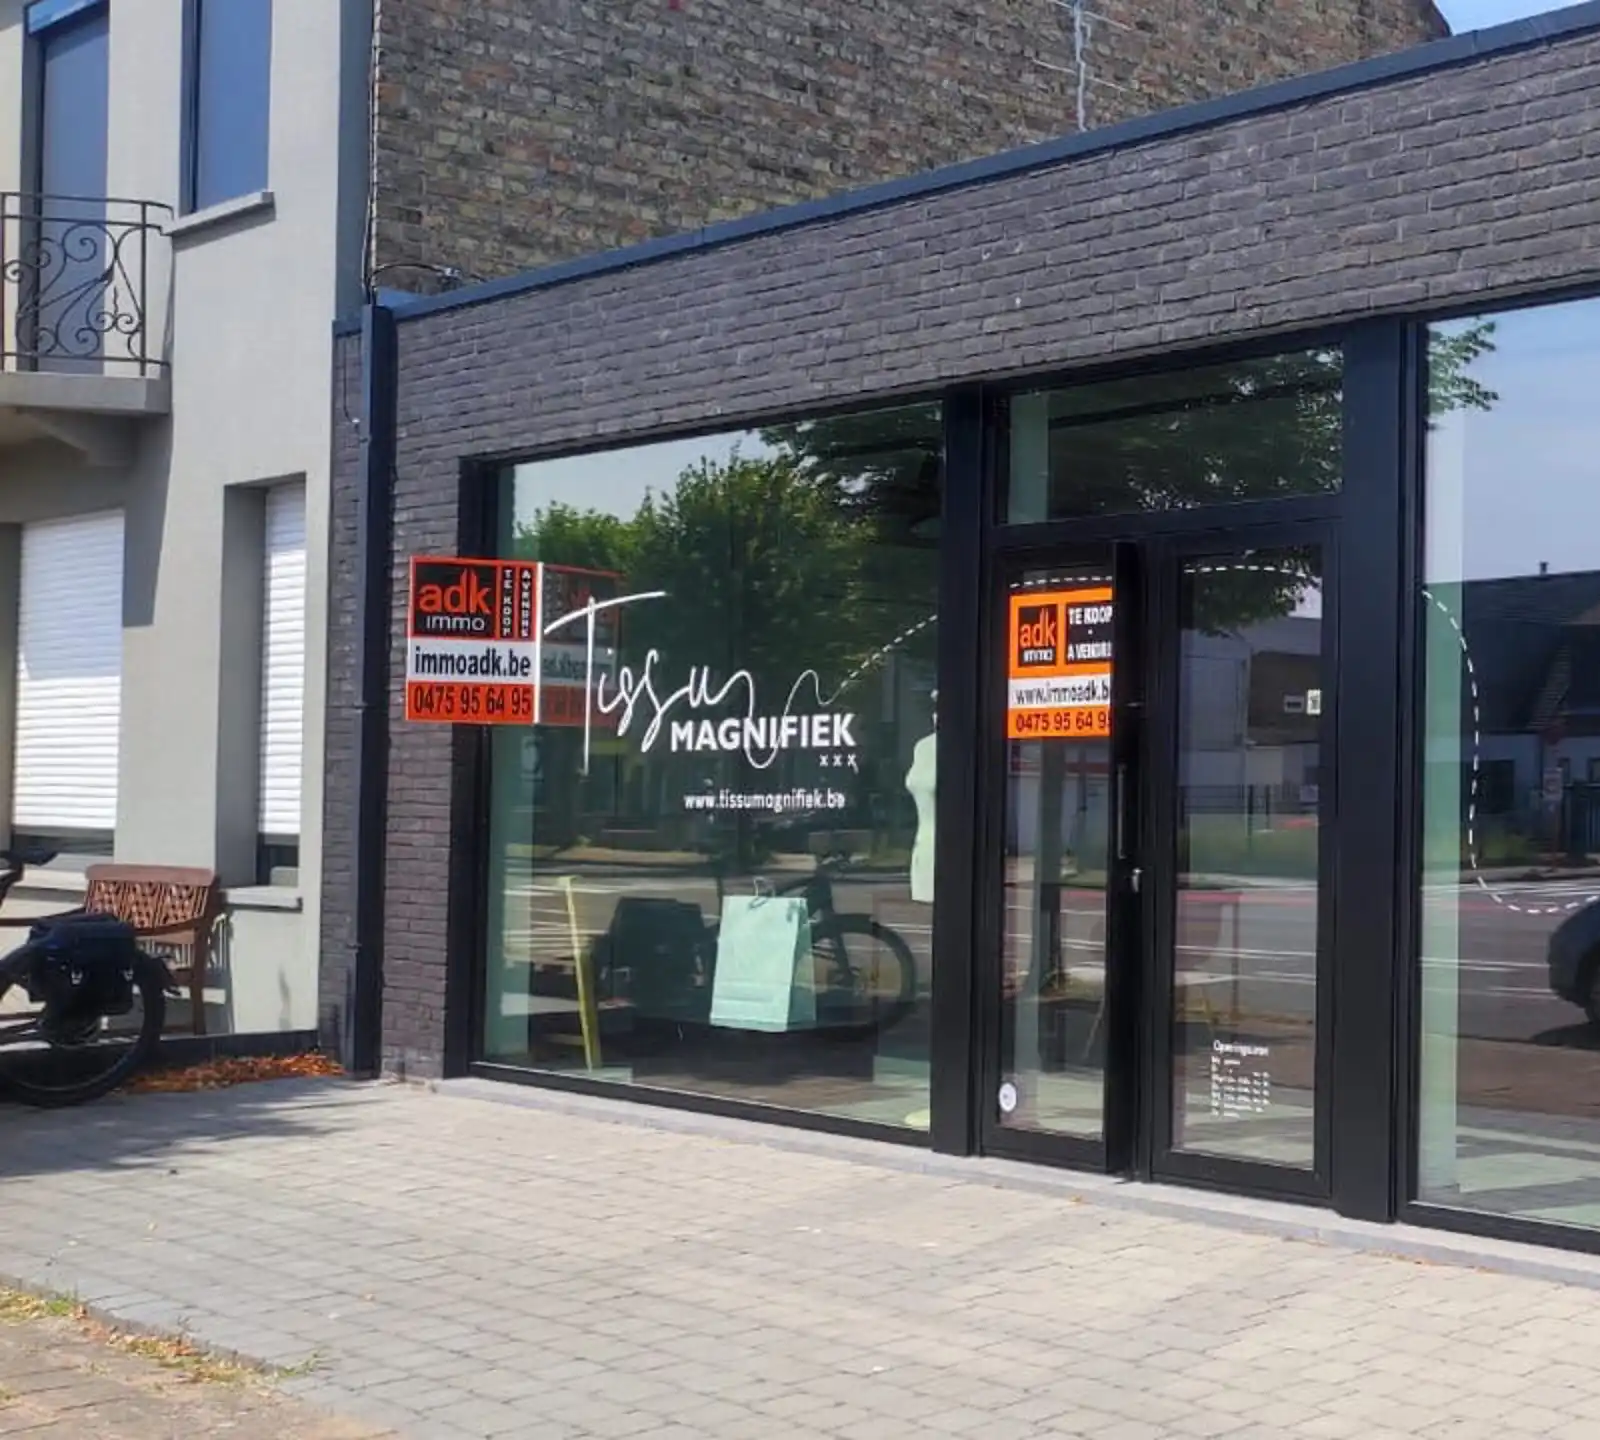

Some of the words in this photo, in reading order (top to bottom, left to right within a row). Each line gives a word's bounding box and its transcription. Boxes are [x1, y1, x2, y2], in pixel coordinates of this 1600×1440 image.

[419, 569, 490, 614] adk
[427, 615, 485, 632] immo
[1020, 608, 1056, 648] adk
[1069, 607, 1082, 625] TE
[1084, 605, 1112, 625] KOOP
[415, 646, 531, 677] immoadk.be
[543, 590, 838, 776] Tissu
[1016, 680, 1109, 704] www.immoadk.b
[414, 685, 454, 714] 0475
[460, 686, 480, 715] 95
[486, 686, 505, 715] 64
[512, 687, 531, 716] 95
[671, 712, 857, 752] MAGNIFIEK
[1016, 713, 1049, 732] 0475
[1054, 711, 1071, 731] 95
[1076, 711, 1093, 730] 64
[1098, 711, 1112, 729] 9
